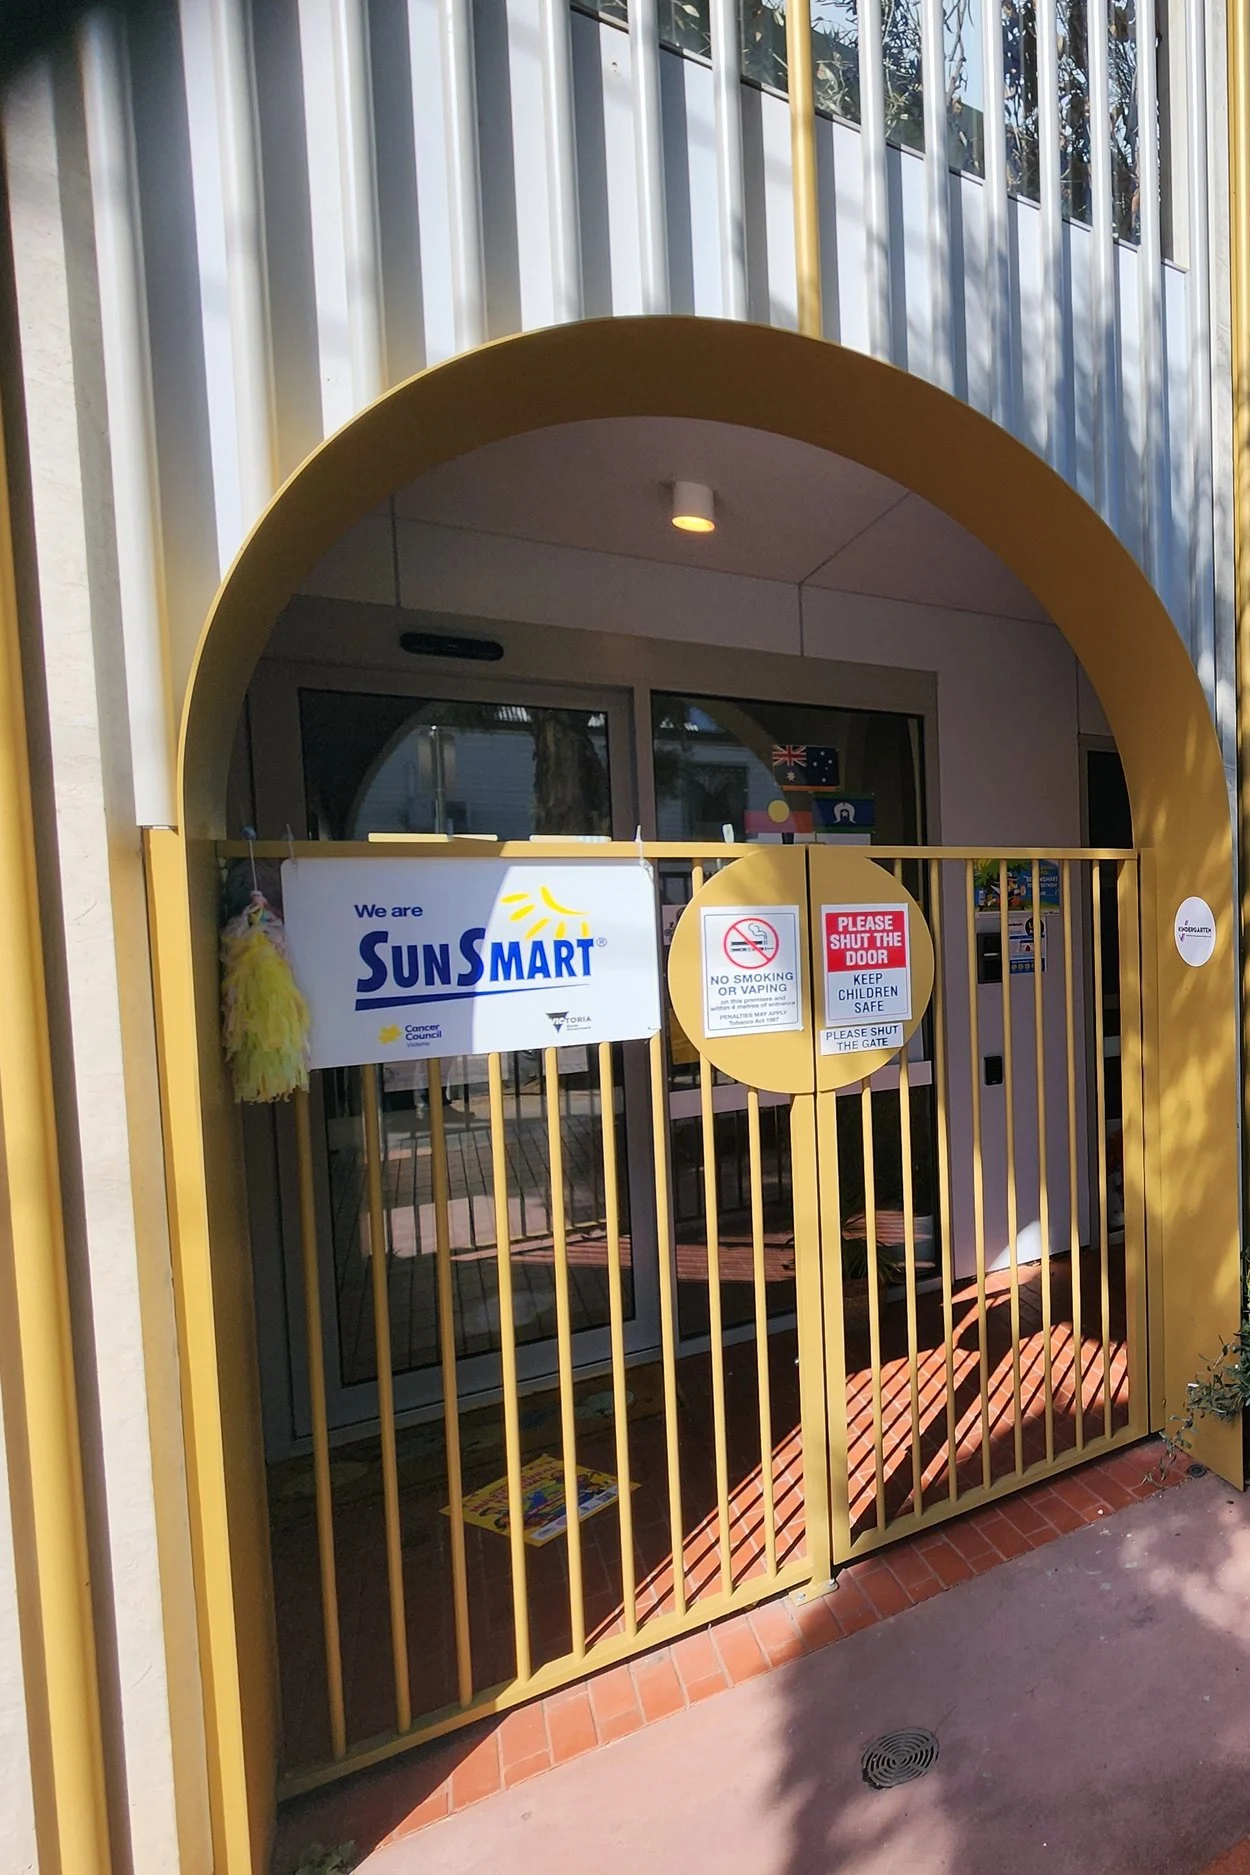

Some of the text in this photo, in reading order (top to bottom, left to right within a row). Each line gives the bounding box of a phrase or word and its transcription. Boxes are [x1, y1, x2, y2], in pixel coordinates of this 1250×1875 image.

[354, 904, 424, 918] We are
[838, 915, 893, 932] PLEASE
[1178, 926, 1211, 934] KINDERGARTEN
[830, 932, 902, 950] SHUT THE
[845, 949, 888, 966] DOOR
[710, 972, 793, 985] NO SMOKING
[853, 973, 883, 986] KEEP
[718, 983, 787, 996] OR VAPING
[838, 985, 898, 1001] CHILDREN
[854, 1001, 884, 1014] SAFE
[551, 1016, 592, 1025] VICTORIA
[405, 1024, 440, 1033] Cancer
[826, 1025, 899, 1041] PLEASE SHUT
[405, 1031, 442, 1041] Council
[837, 1037, 888, 1051] THE GATE
